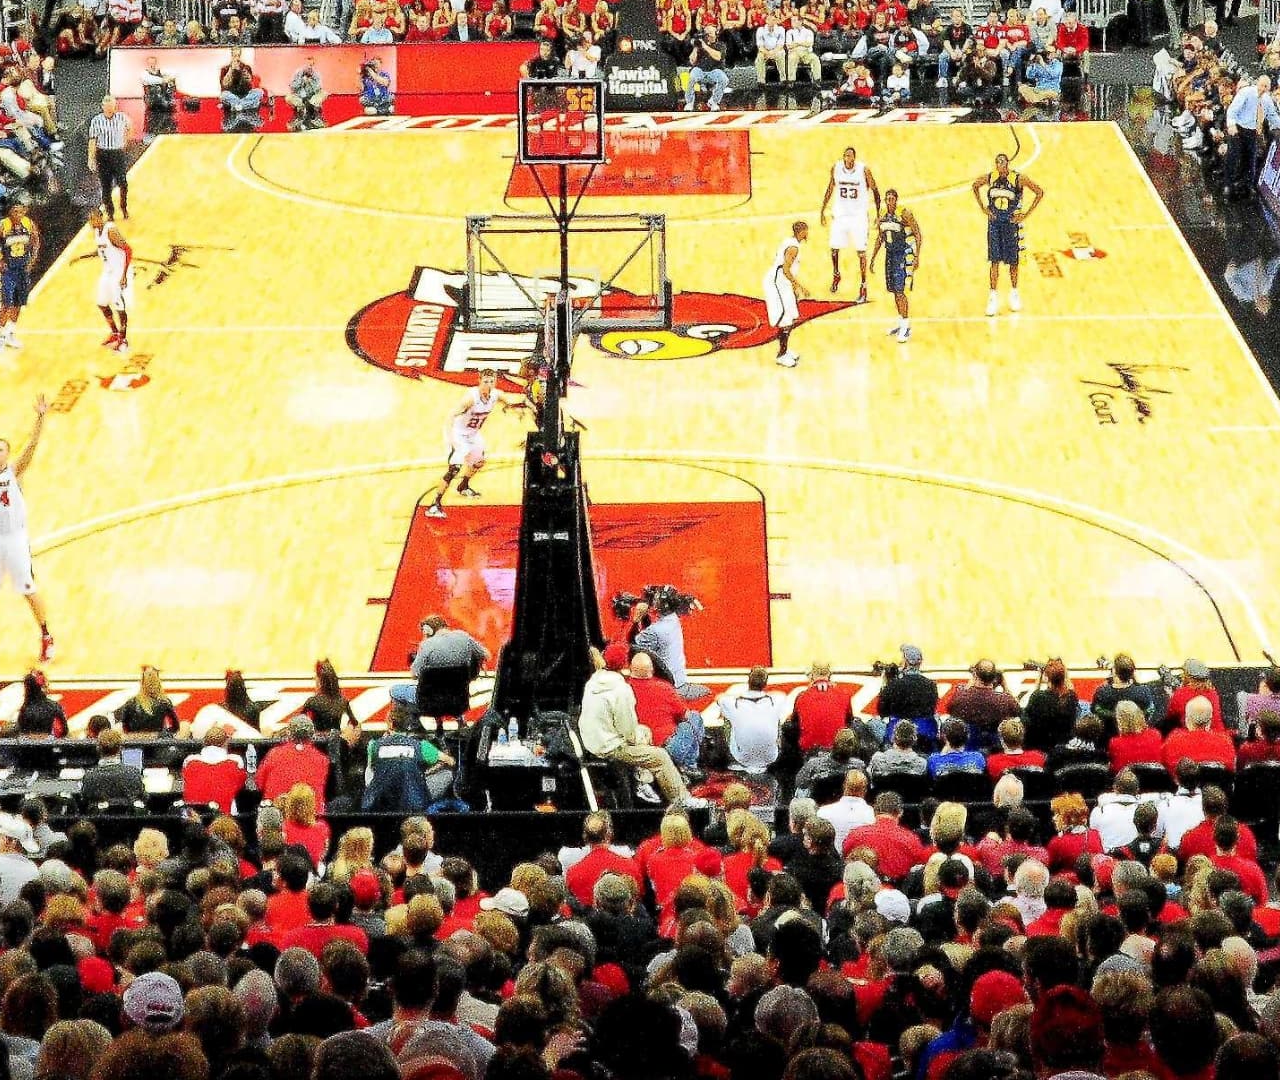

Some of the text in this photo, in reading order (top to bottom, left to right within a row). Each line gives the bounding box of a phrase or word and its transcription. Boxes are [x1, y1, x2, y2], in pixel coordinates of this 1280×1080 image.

[632, 39, 657, 51] PNC
[608, 66, 661, 81] Jewish
[609, 79, 669, 97] Hospital
[839, 187, 859, 199] 23
